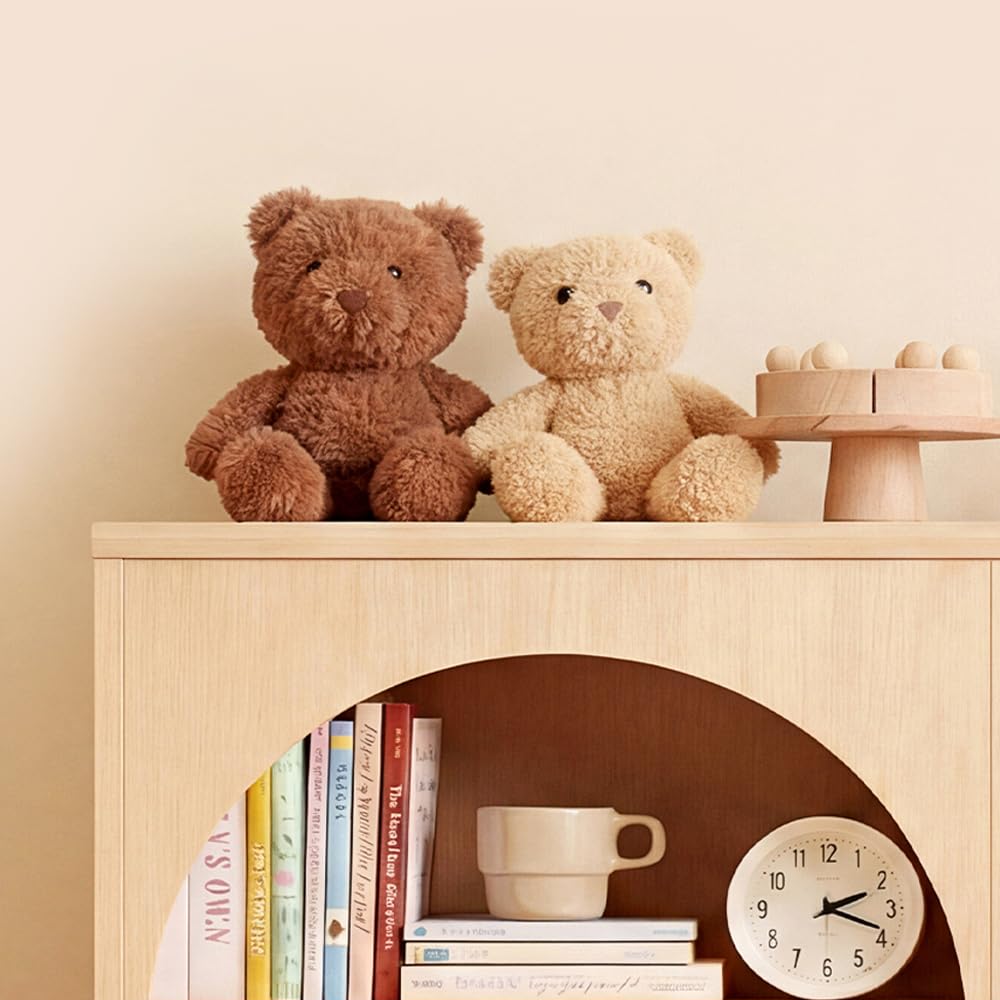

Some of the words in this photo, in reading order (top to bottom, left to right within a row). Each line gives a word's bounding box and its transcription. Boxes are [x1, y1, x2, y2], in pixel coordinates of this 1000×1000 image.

[792, 849, 805, 868] 11
[820, 843, 838, 863] 12
[855, 849, 861, 868] 1
[769, 871, 786, 891] 10
[877, 870, 887, 890] 2
[757, 900, 768, 919] 9
[886, 899, 897, 919] 3
[768, 928, 778, 949] 8
[875, 928, 888, 949] 4
[792, 948, 801, 968] 7
[822, 957, 833, 978] 6
[853, 949, 864, 968] 5
